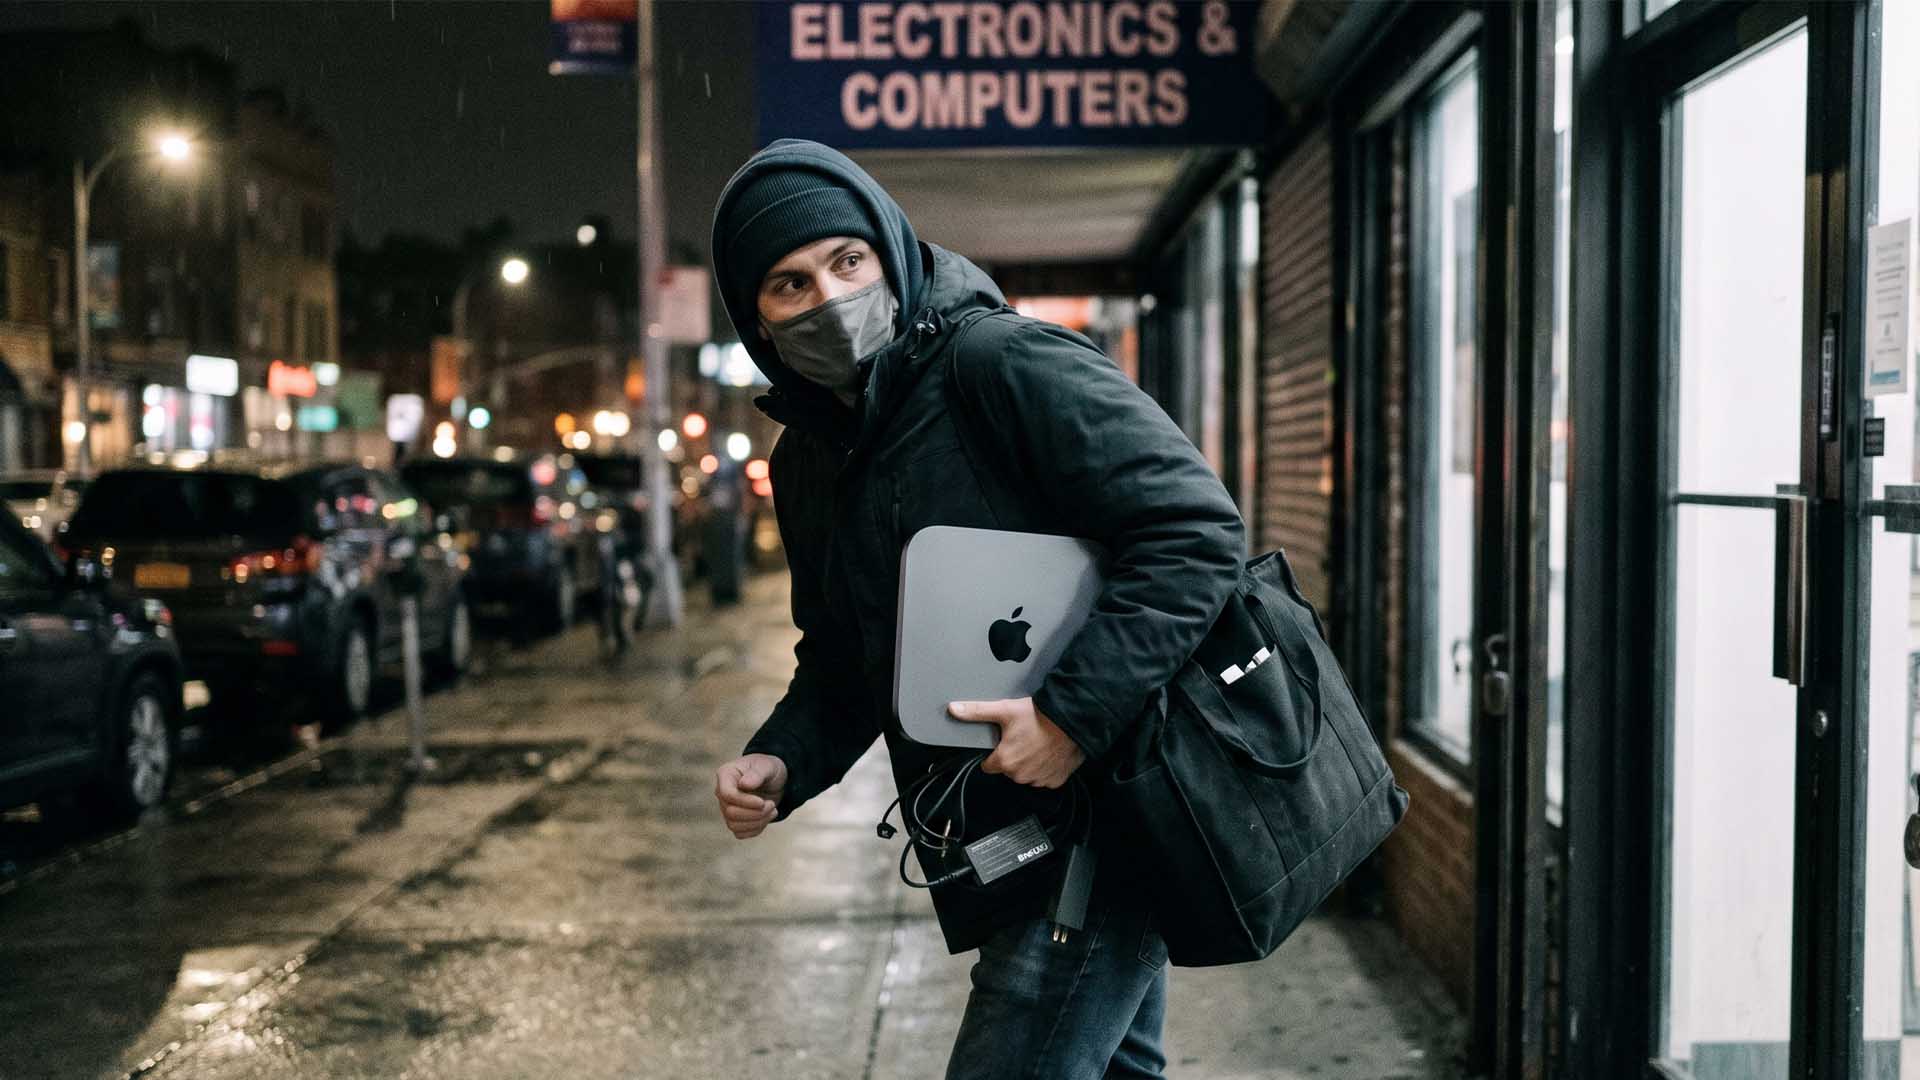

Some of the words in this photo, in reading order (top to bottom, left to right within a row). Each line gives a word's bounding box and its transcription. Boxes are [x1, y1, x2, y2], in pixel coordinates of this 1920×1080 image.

[790, 2, 1180, 59] ELECTRONICS
[1197, 2, 1237, 54] &
[840, 70, 1188, 130] COMPUTERS
